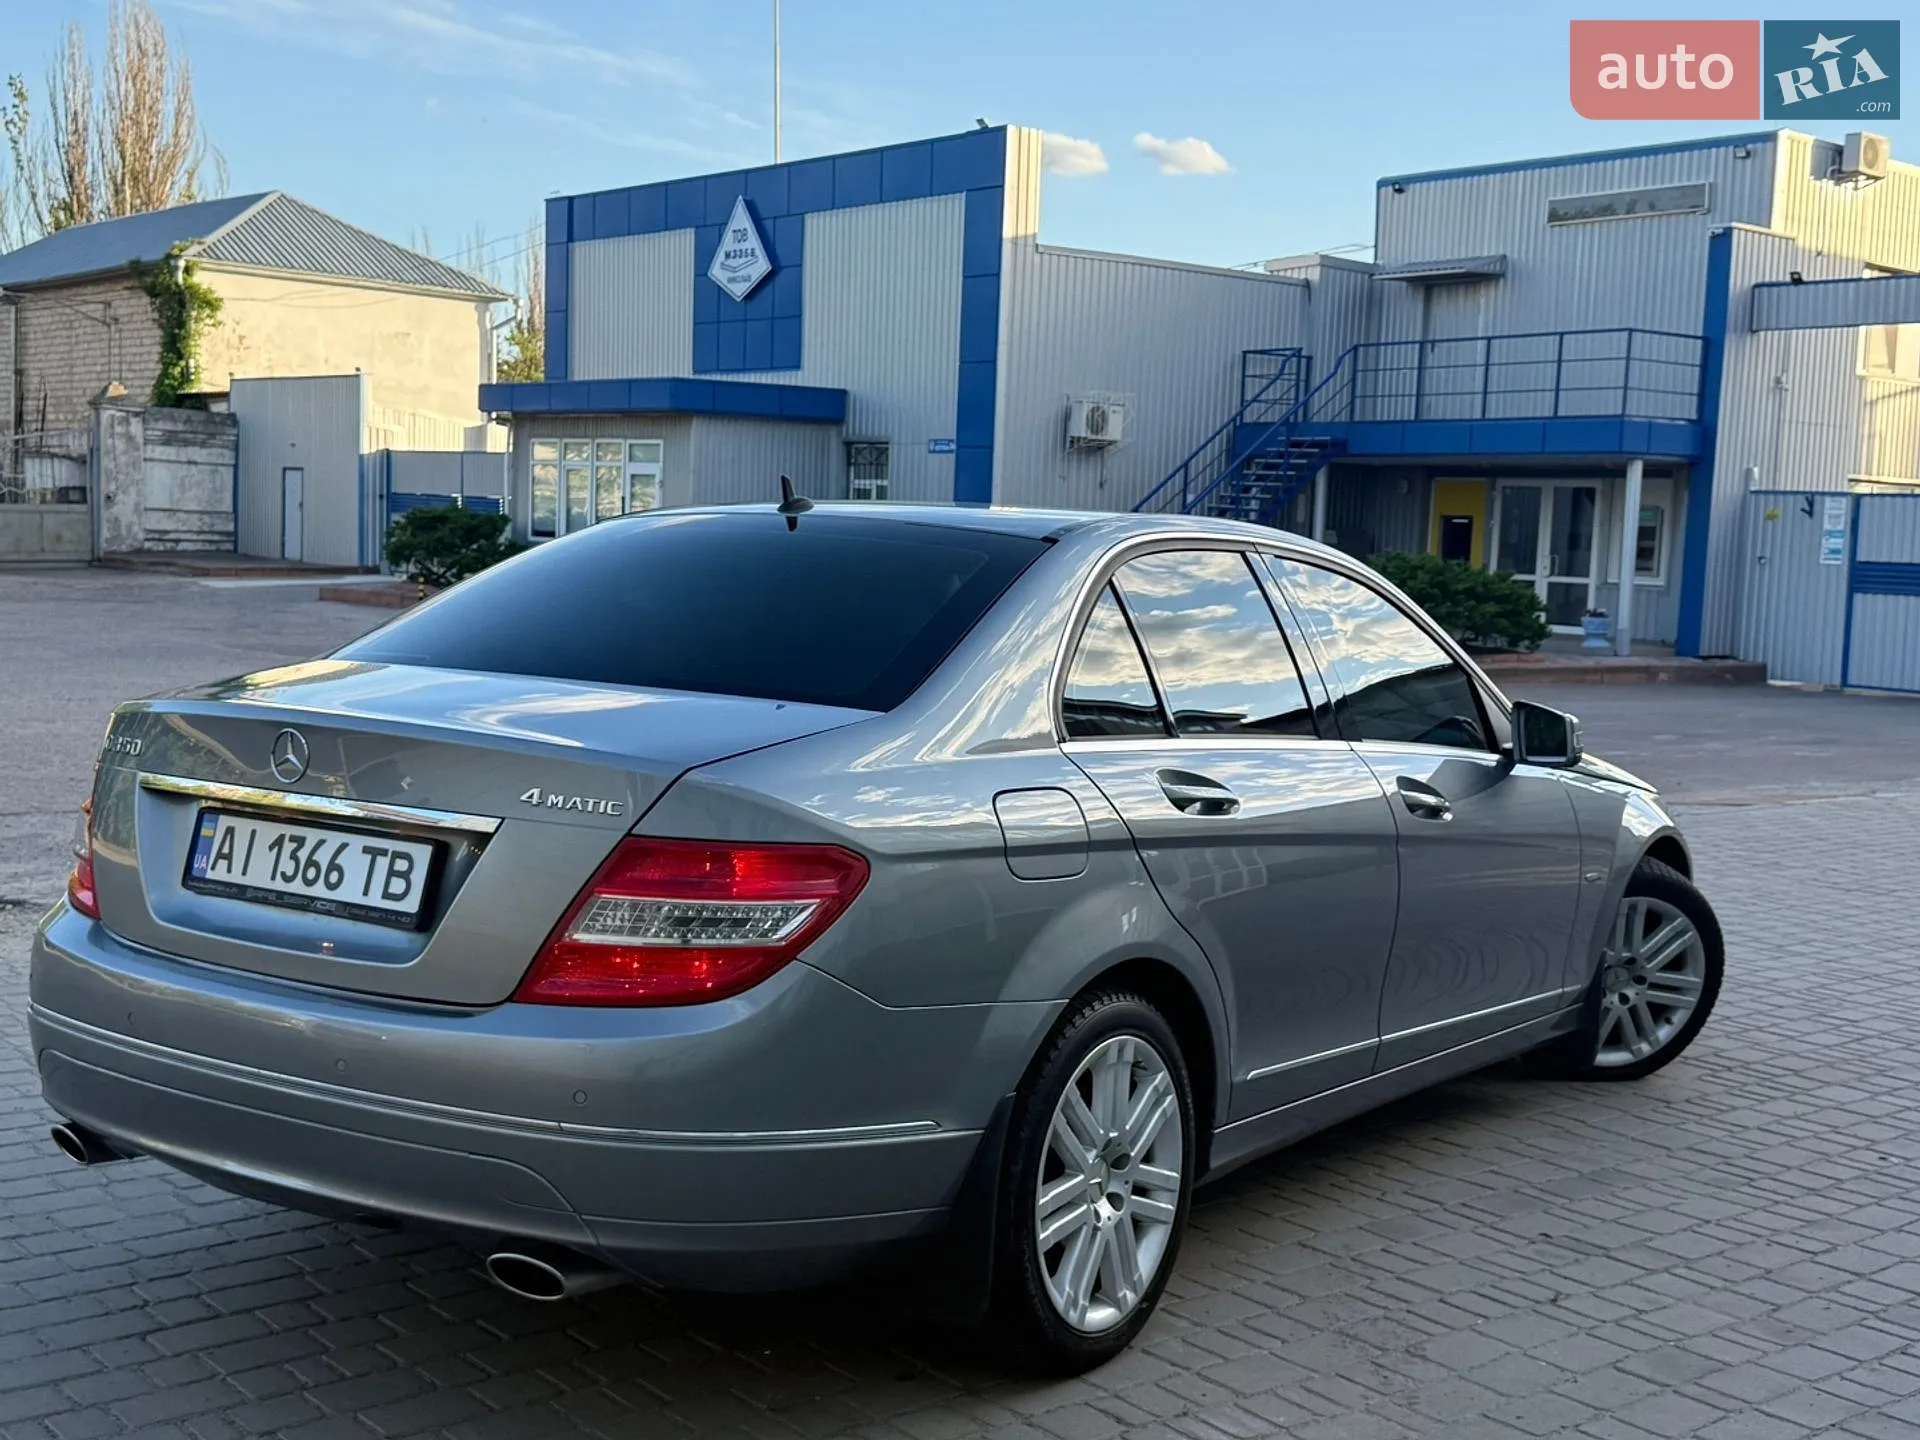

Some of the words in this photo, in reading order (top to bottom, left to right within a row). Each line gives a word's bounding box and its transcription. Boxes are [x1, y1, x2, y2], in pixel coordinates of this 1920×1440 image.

[519, 786, 625, 816] 4MATIC
[194, 854, 208, 869] UA
[210, 825, 257, 877] AI
[268, 832, 350, 892] 1366
[361, 844, 415, 902] TB
